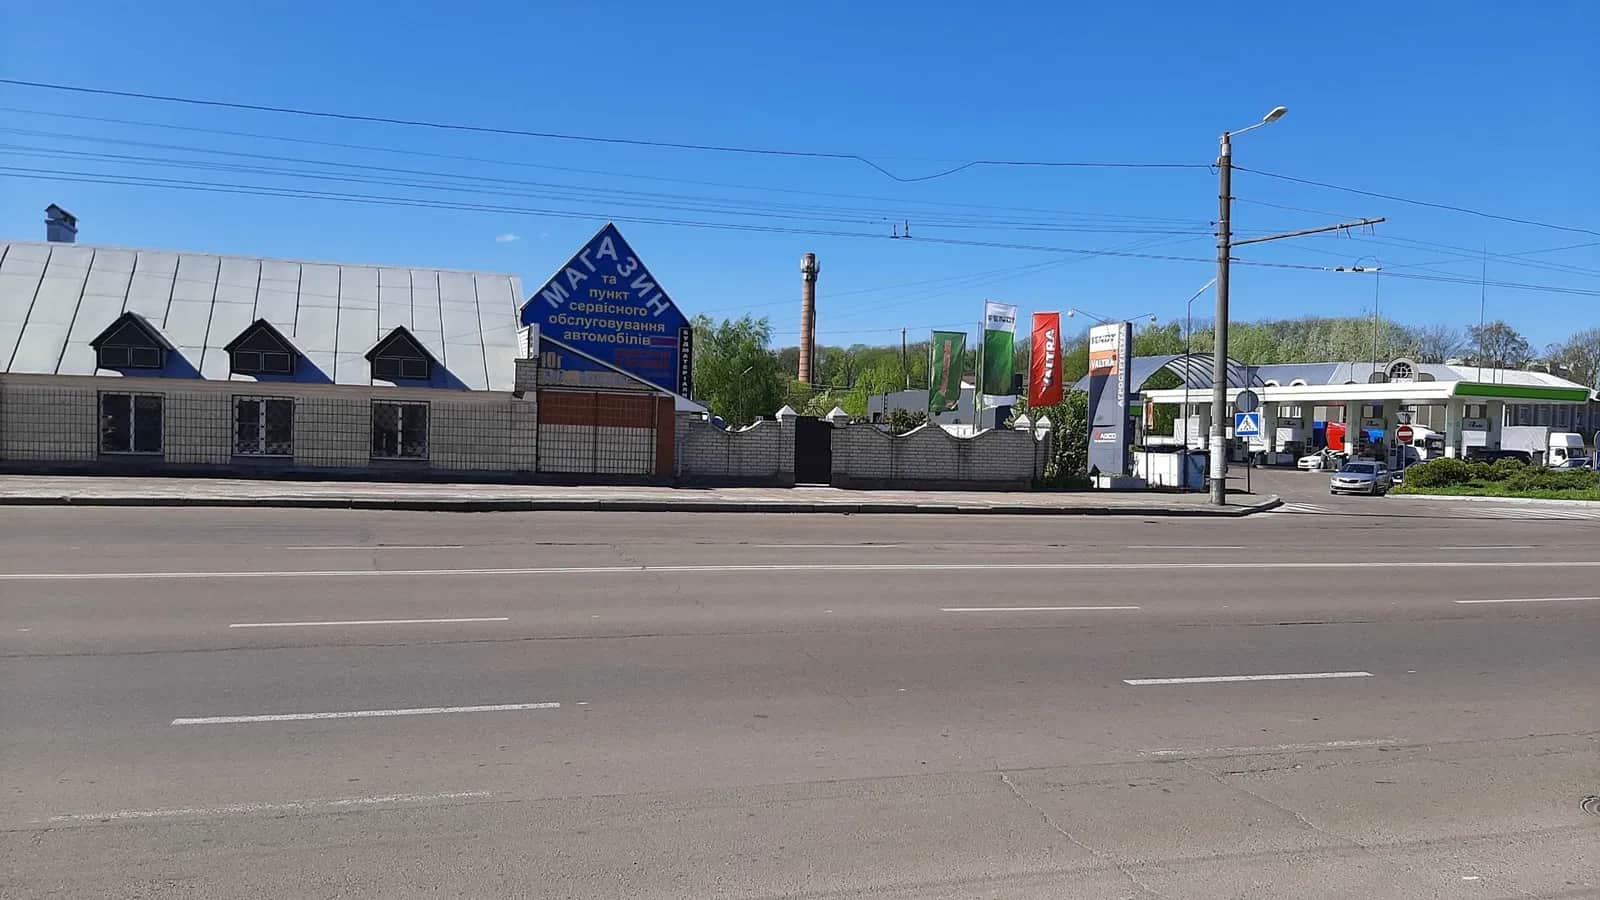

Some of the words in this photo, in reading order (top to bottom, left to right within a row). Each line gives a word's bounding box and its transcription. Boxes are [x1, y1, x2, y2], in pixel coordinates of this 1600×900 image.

[541, 236, 671, 318] МАГАЗИН
[602, 275, 617, 285] та
[589, 288, 630, 301] пункт
[569, 301, 648, 317] сервісного
[548, 314, 665, 333] обслуговування
[563, 330, 650, 346] автомобілів
